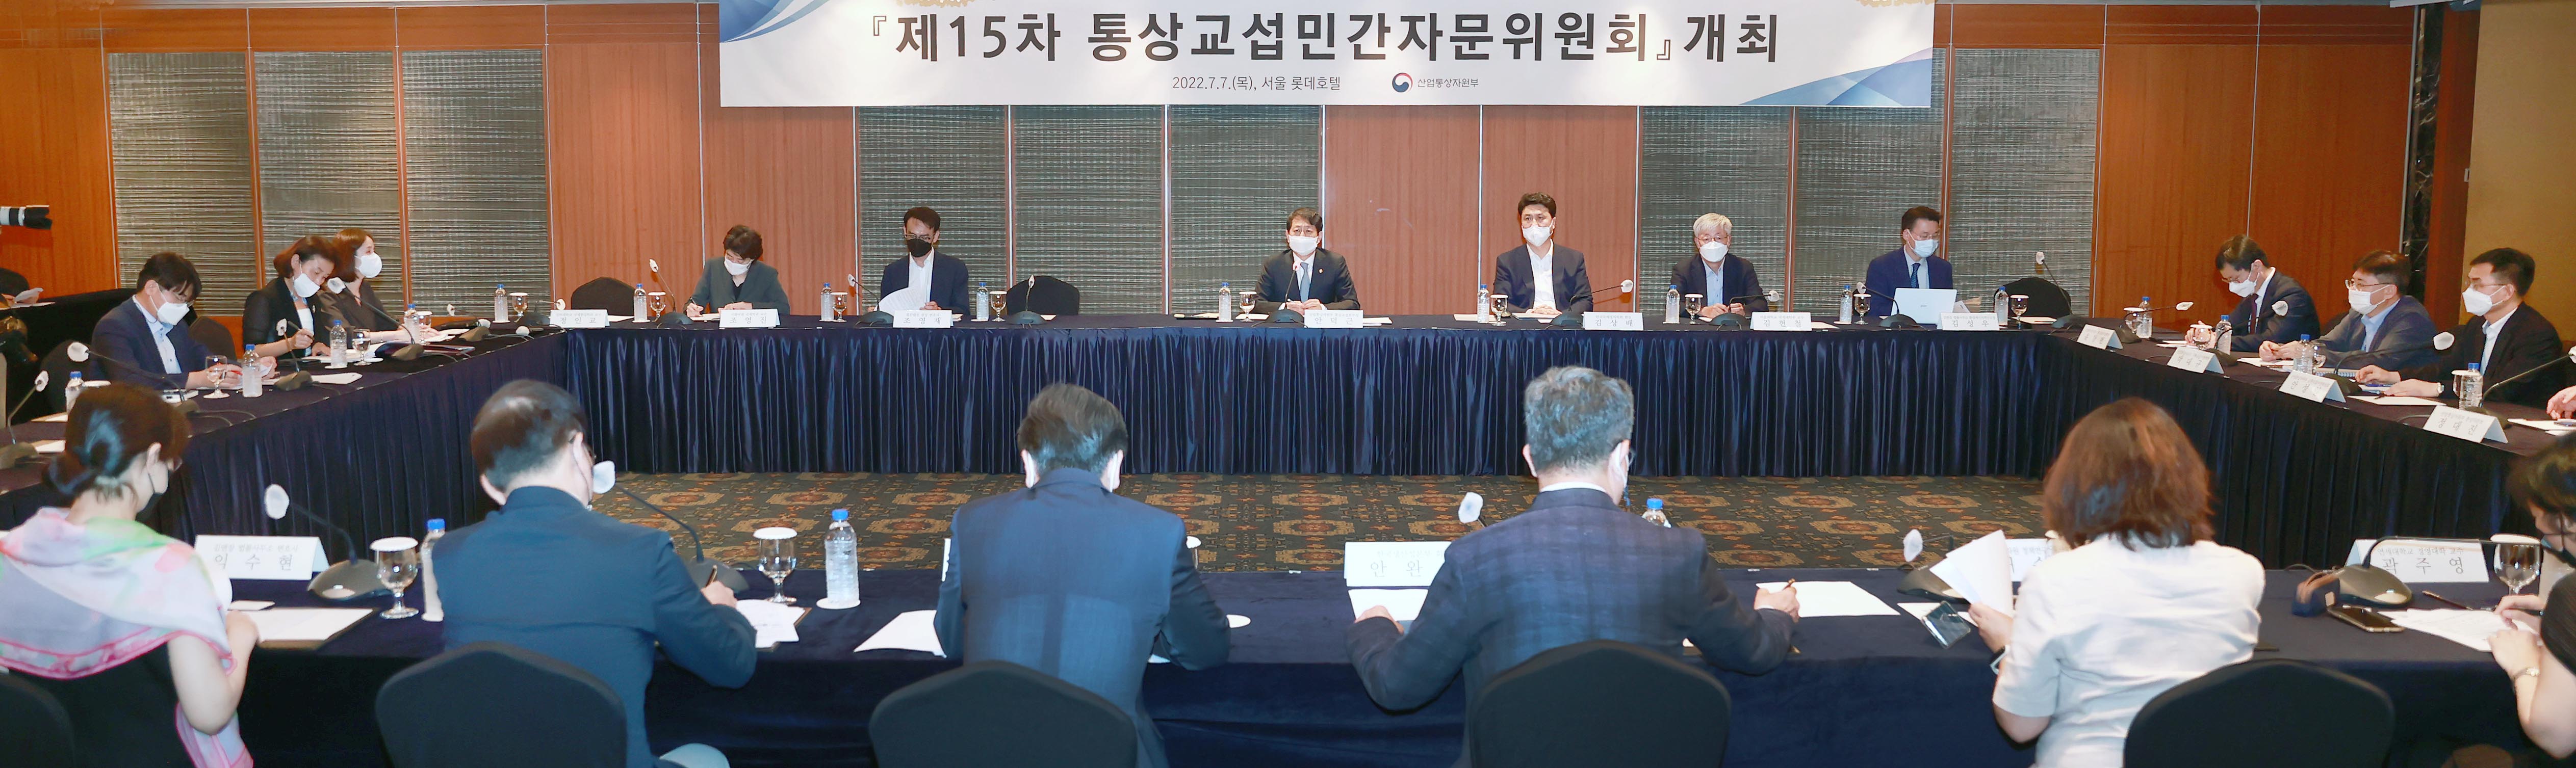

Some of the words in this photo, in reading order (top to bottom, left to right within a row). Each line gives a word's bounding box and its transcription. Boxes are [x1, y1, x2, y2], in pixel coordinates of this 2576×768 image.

[872, 14, 1061, 62] 『제15차
[1172, 76, 1257, 91] 2022.7.7.(목),
[1261, 76, 1286, 90] 서울
[1291, 76, 1341, 90] 롯데호텔
[1418, 78, 1479, 88] 산업통상자원부
